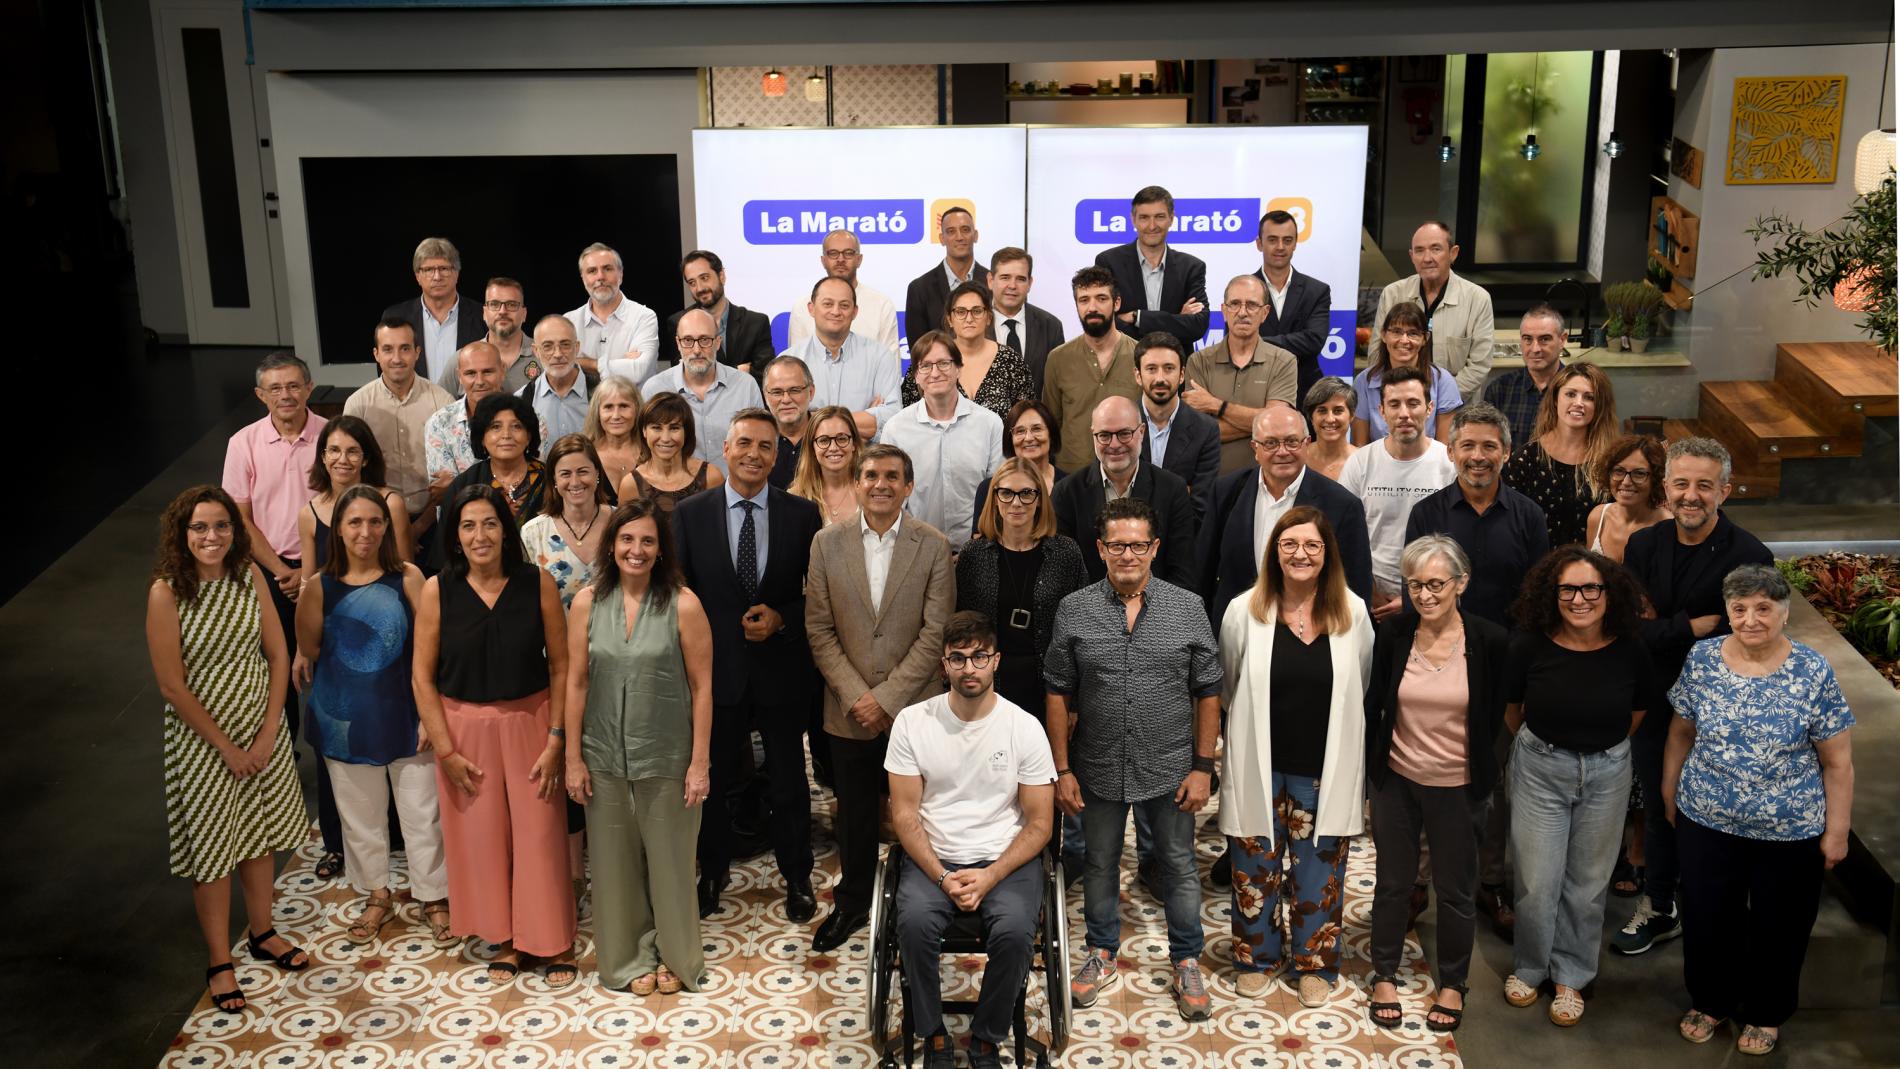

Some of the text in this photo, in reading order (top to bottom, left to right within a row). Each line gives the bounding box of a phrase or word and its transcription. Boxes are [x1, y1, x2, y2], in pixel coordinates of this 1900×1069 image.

[760, 209, 908, 233] La Marató
[1092, 209, 1242, 232] La rató
